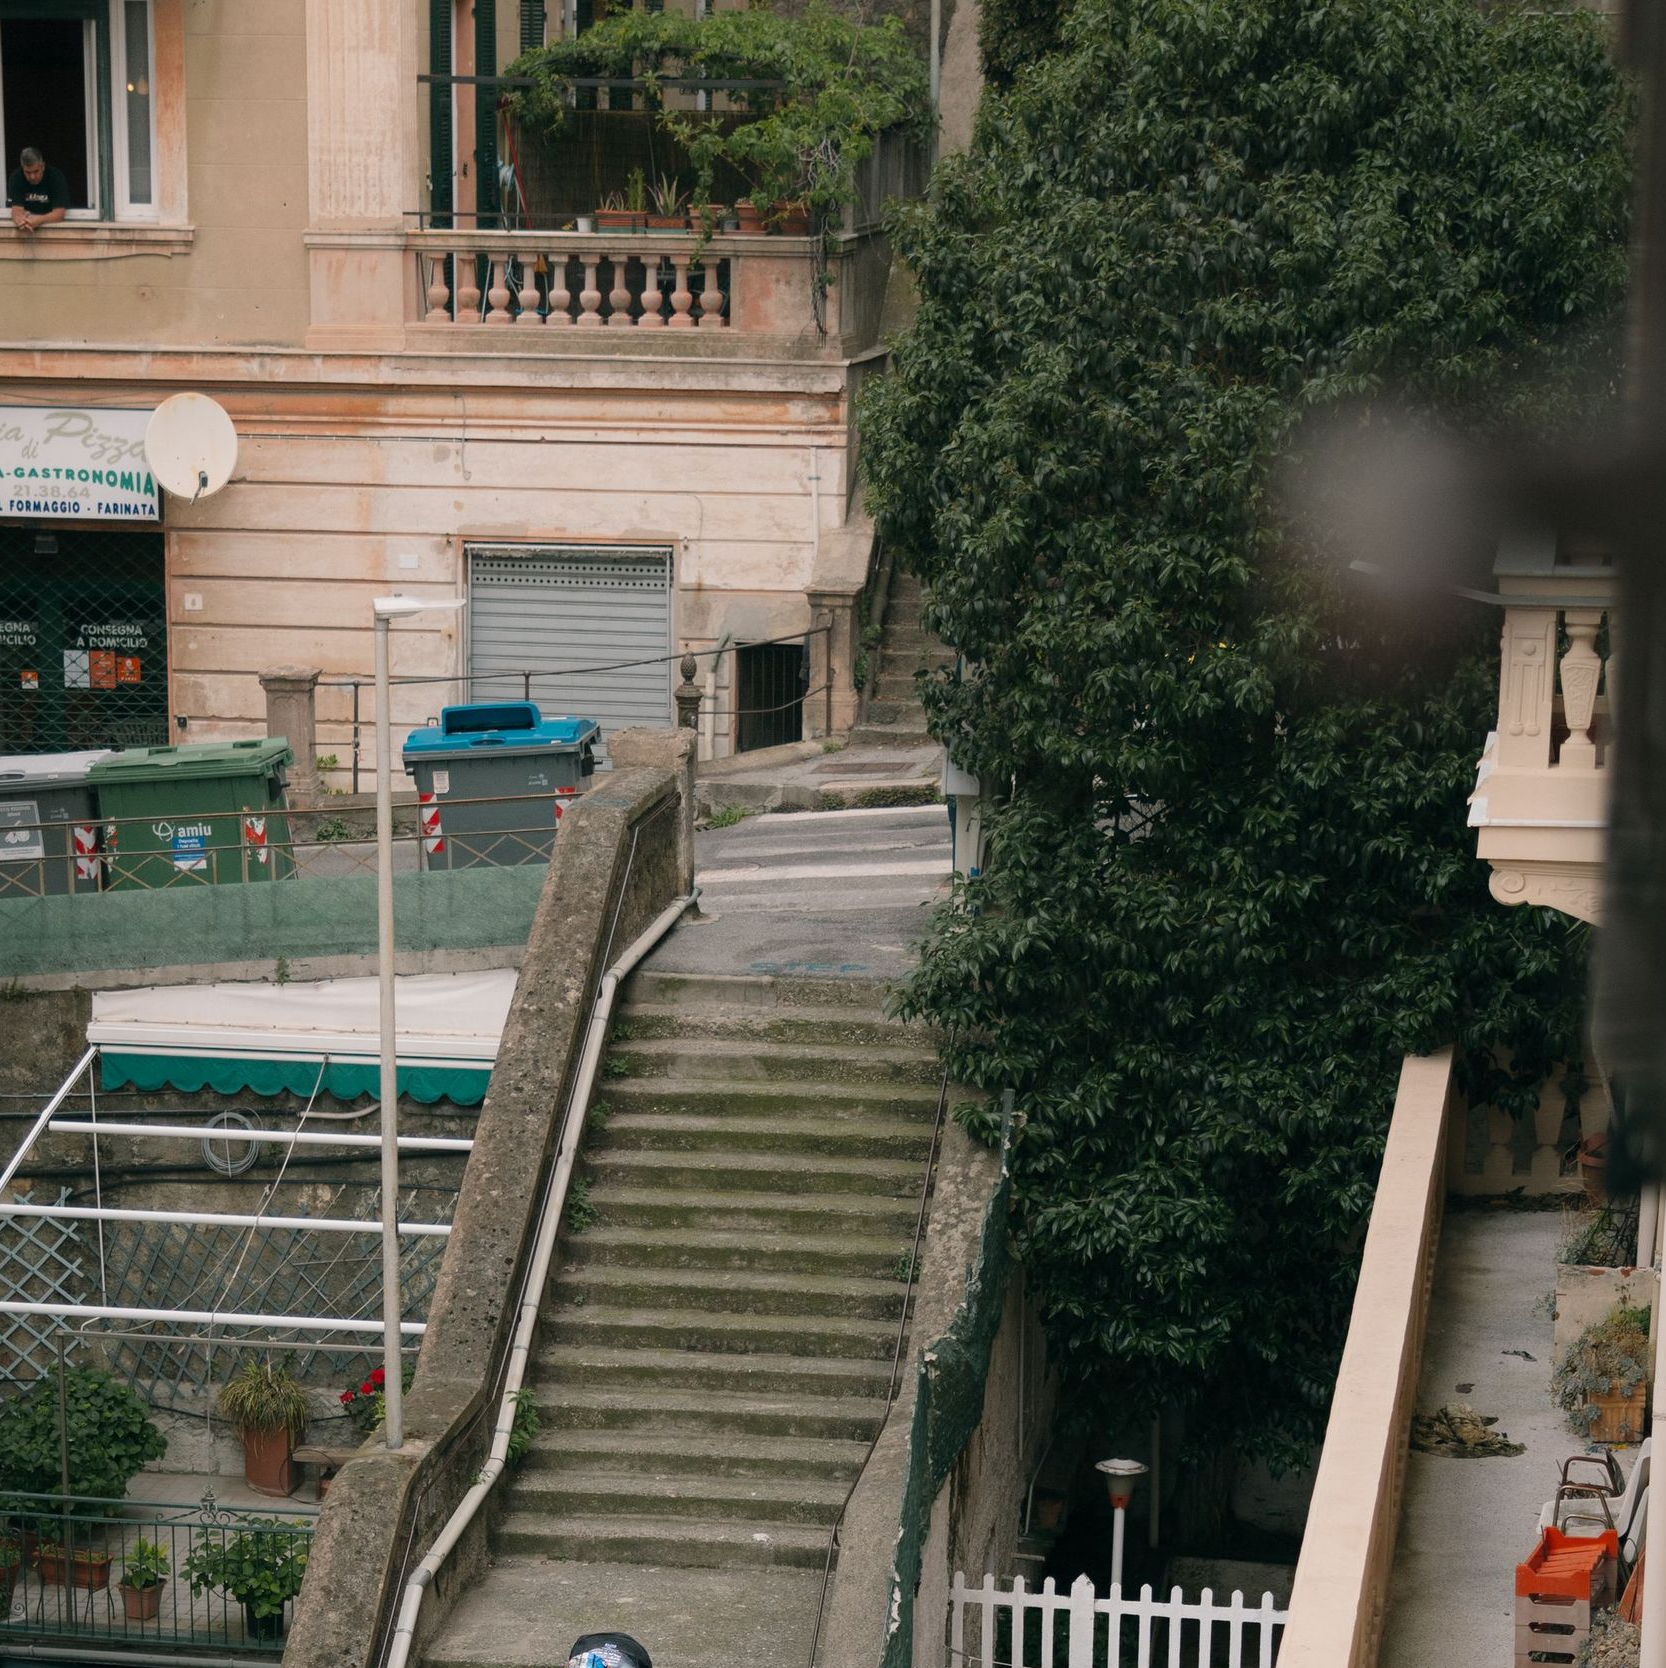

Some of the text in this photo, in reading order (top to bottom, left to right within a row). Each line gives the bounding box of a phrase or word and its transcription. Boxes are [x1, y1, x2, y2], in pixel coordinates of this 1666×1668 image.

[21, 439, 39, 459] di
[43, 411, 146, 464] Pizza
[13, 484, 90, 498] 21.38.64
[10, 500, 81, 514] FORMAGGIO
[97, 502, 156, 516] FARINATA
[80, 624, 143, 636] CONSEGNA
[76, 636, 148, 648] A DOMICILIO
[178, 822, 212, 838] amiu
